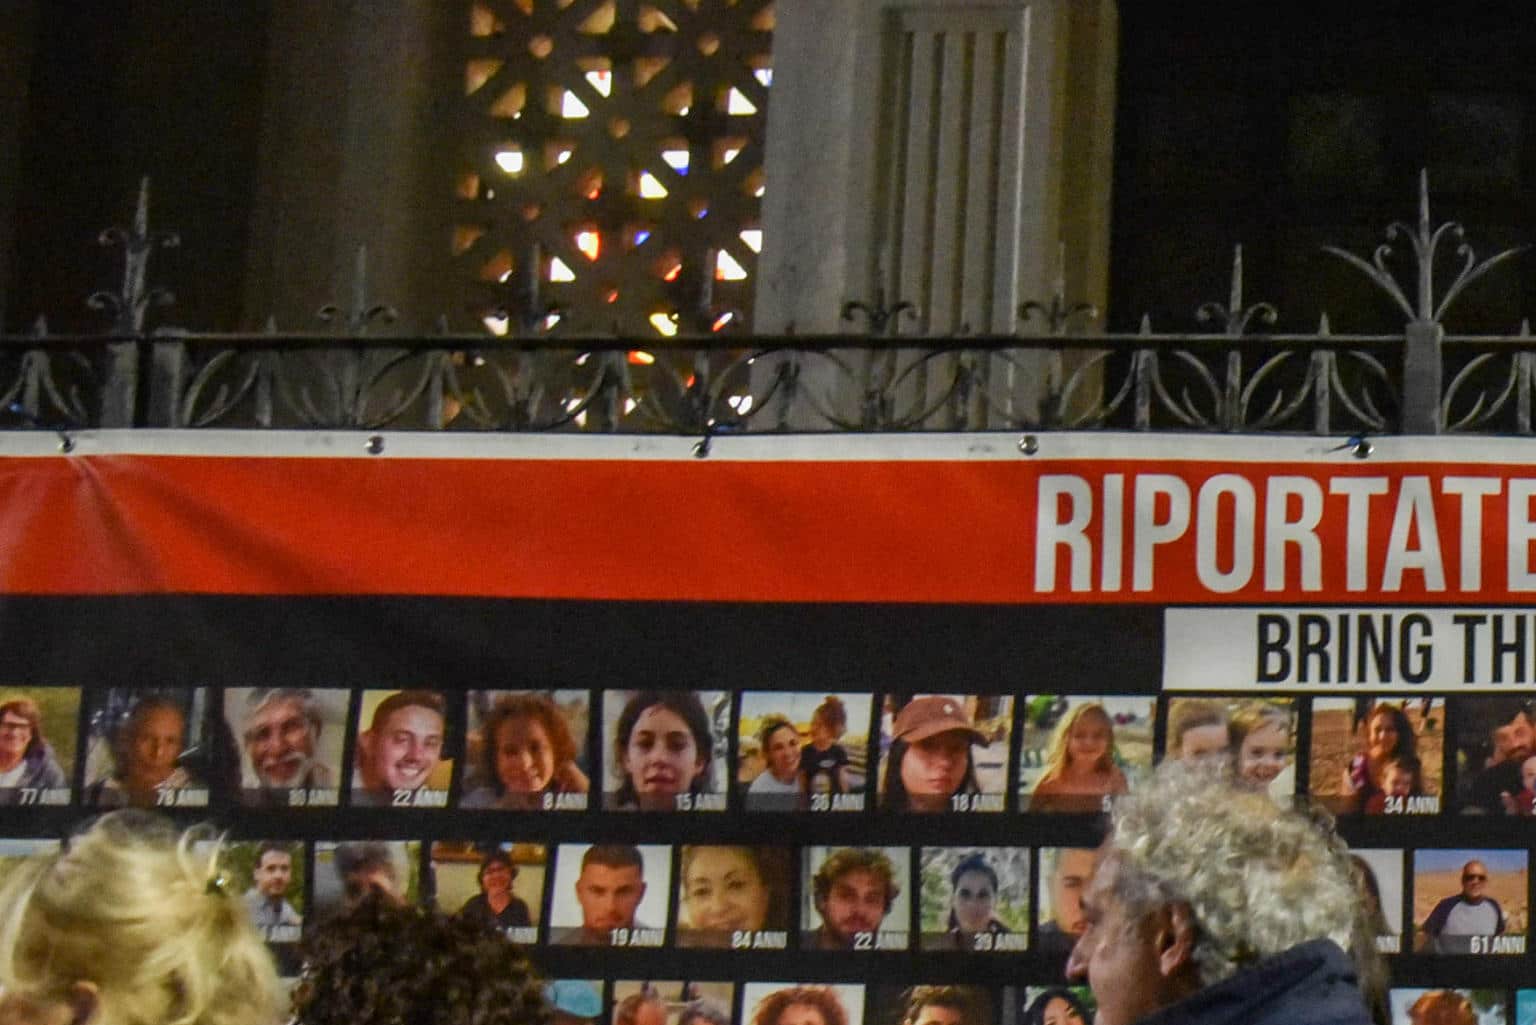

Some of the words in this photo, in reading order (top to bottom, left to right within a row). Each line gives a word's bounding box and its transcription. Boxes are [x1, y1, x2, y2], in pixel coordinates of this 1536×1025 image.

[1256, 613, 1433, 684] BRING
[20, 788, 38, 806] 77
[38, 788, 72, 806] ANNI
[175, 789, 209, 806] ANNI
[307, 789, 340, 806] ANNI
[392, 789, 412, 807] 22
[413, 789, 449, 807] ANNI
[555, 792, 588, 810] ANNI
[693, 793, 727, 811] ANNI
[831, 793, 865, 811] ANNI
[952, 793, 970, 812] 18
[970, 793, 1005, 812] ANNI
[1384, 795, 1402, 814] 34
[1405, 795, 1440, 814] ANNI
[629, 928, 664, 946] ANNI
[753, 931, 787, 949] ANNI
[854, 931, 872, 950] 22
[874, 931, 909, 950] ANNI
[994, 933, 1028, 951] ANNI
[1376, 935, 1400, 954] NNI
[1491, 936, 1526, 954] ANNI
